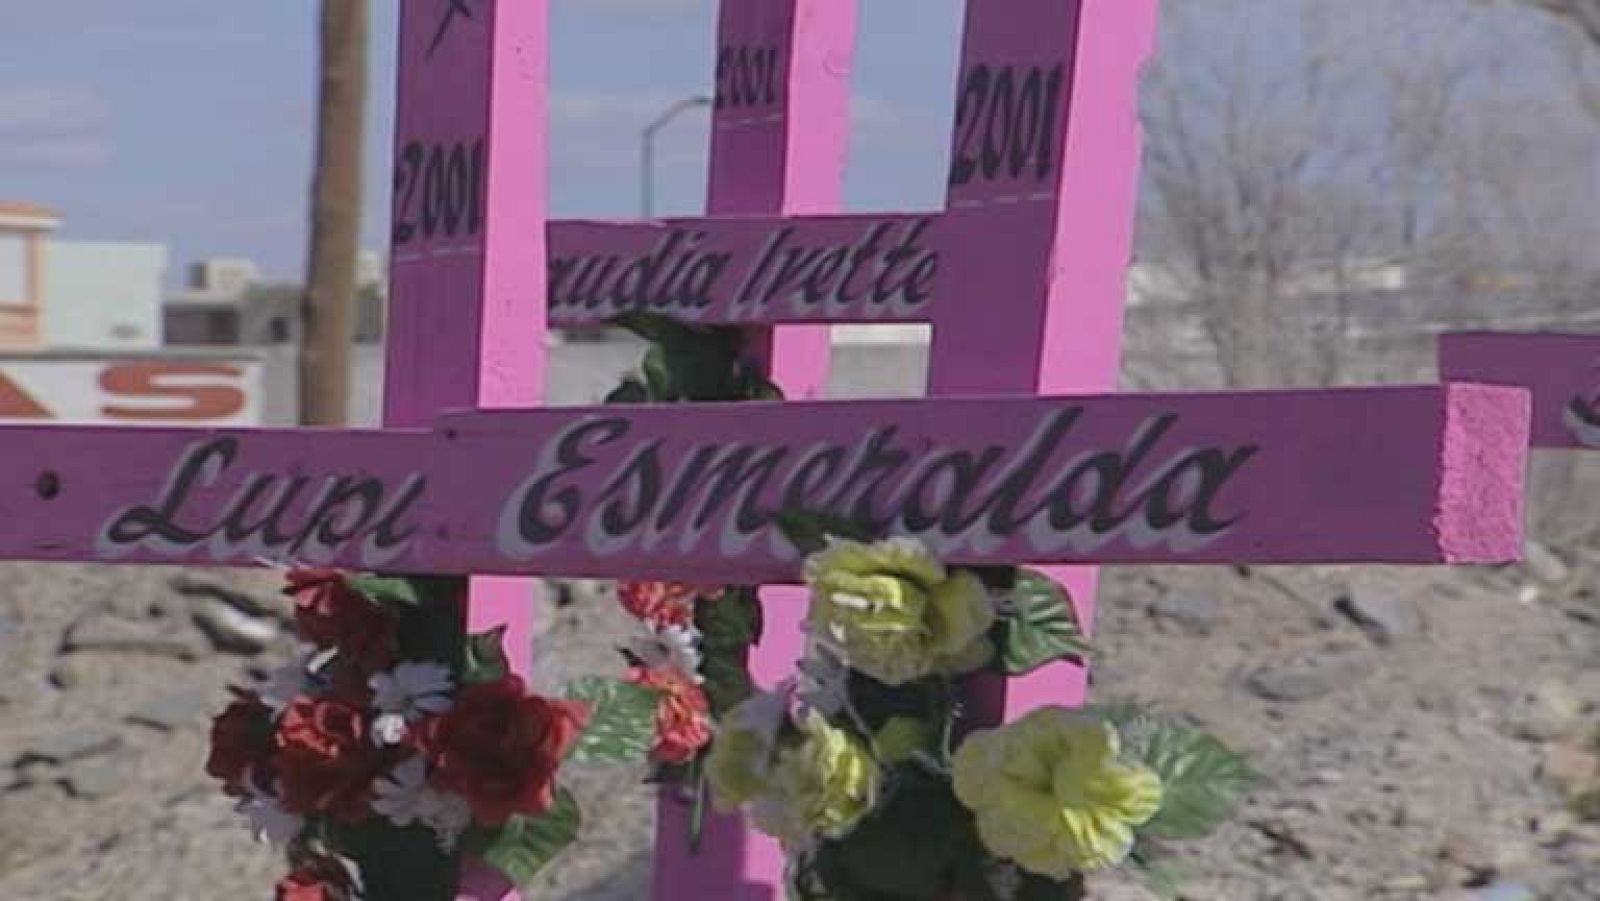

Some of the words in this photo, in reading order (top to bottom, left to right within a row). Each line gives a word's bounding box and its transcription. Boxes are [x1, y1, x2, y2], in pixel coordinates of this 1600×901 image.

[714, 45, 778, 111] 2001
[949, 62, 1063, 184] 2001
[393, 137, 485, 243] 2001
[730, 216, 939, 314] Ivette
[505, 406, 1260, 552] Esmeralda
